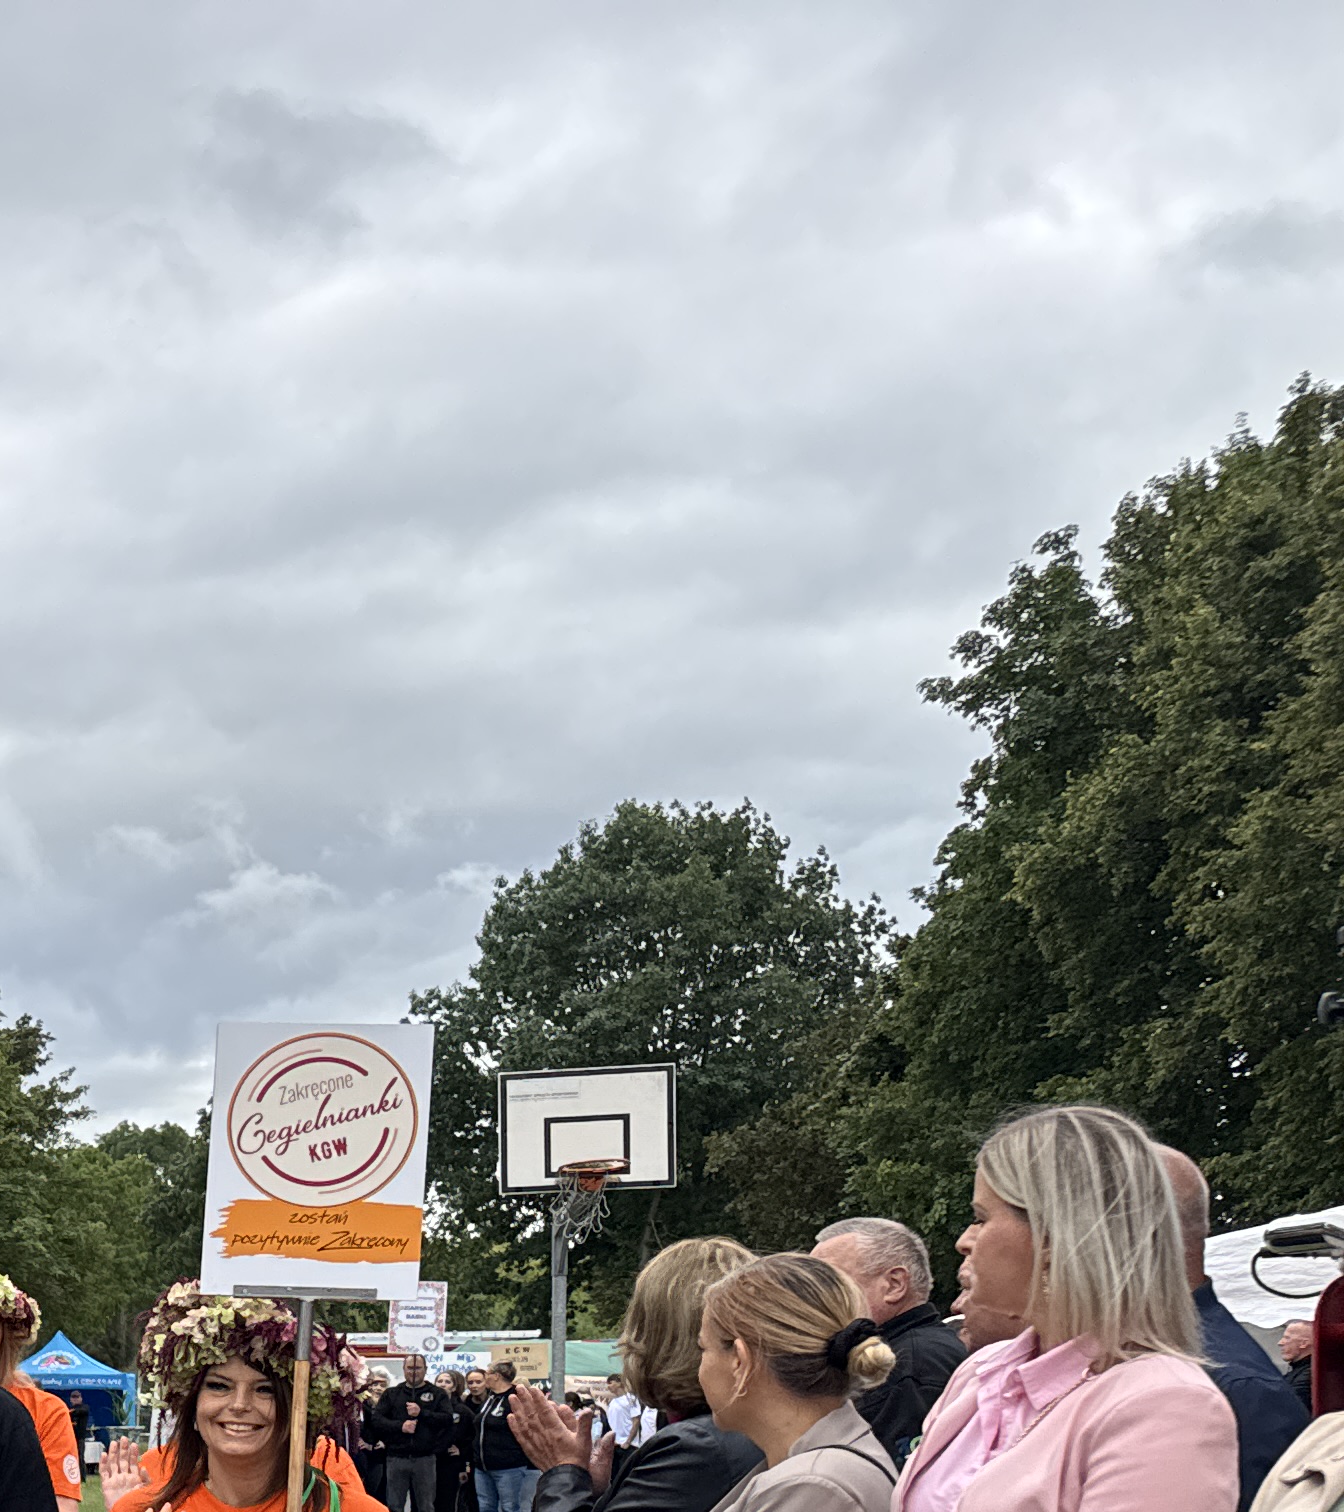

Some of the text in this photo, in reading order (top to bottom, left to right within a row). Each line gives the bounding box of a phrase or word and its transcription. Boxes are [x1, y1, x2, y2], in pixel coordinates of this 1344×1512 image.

[279, 1073, 354, 1106] Zakręcone
[237, 1077, 403, 1156] Cegielnianki
[308, 1137, 348, 1163] KGW
[288, 1210, 349, 1226] zostań
[231, 1230, 410, 1254] pozytywnie Zakręcony
